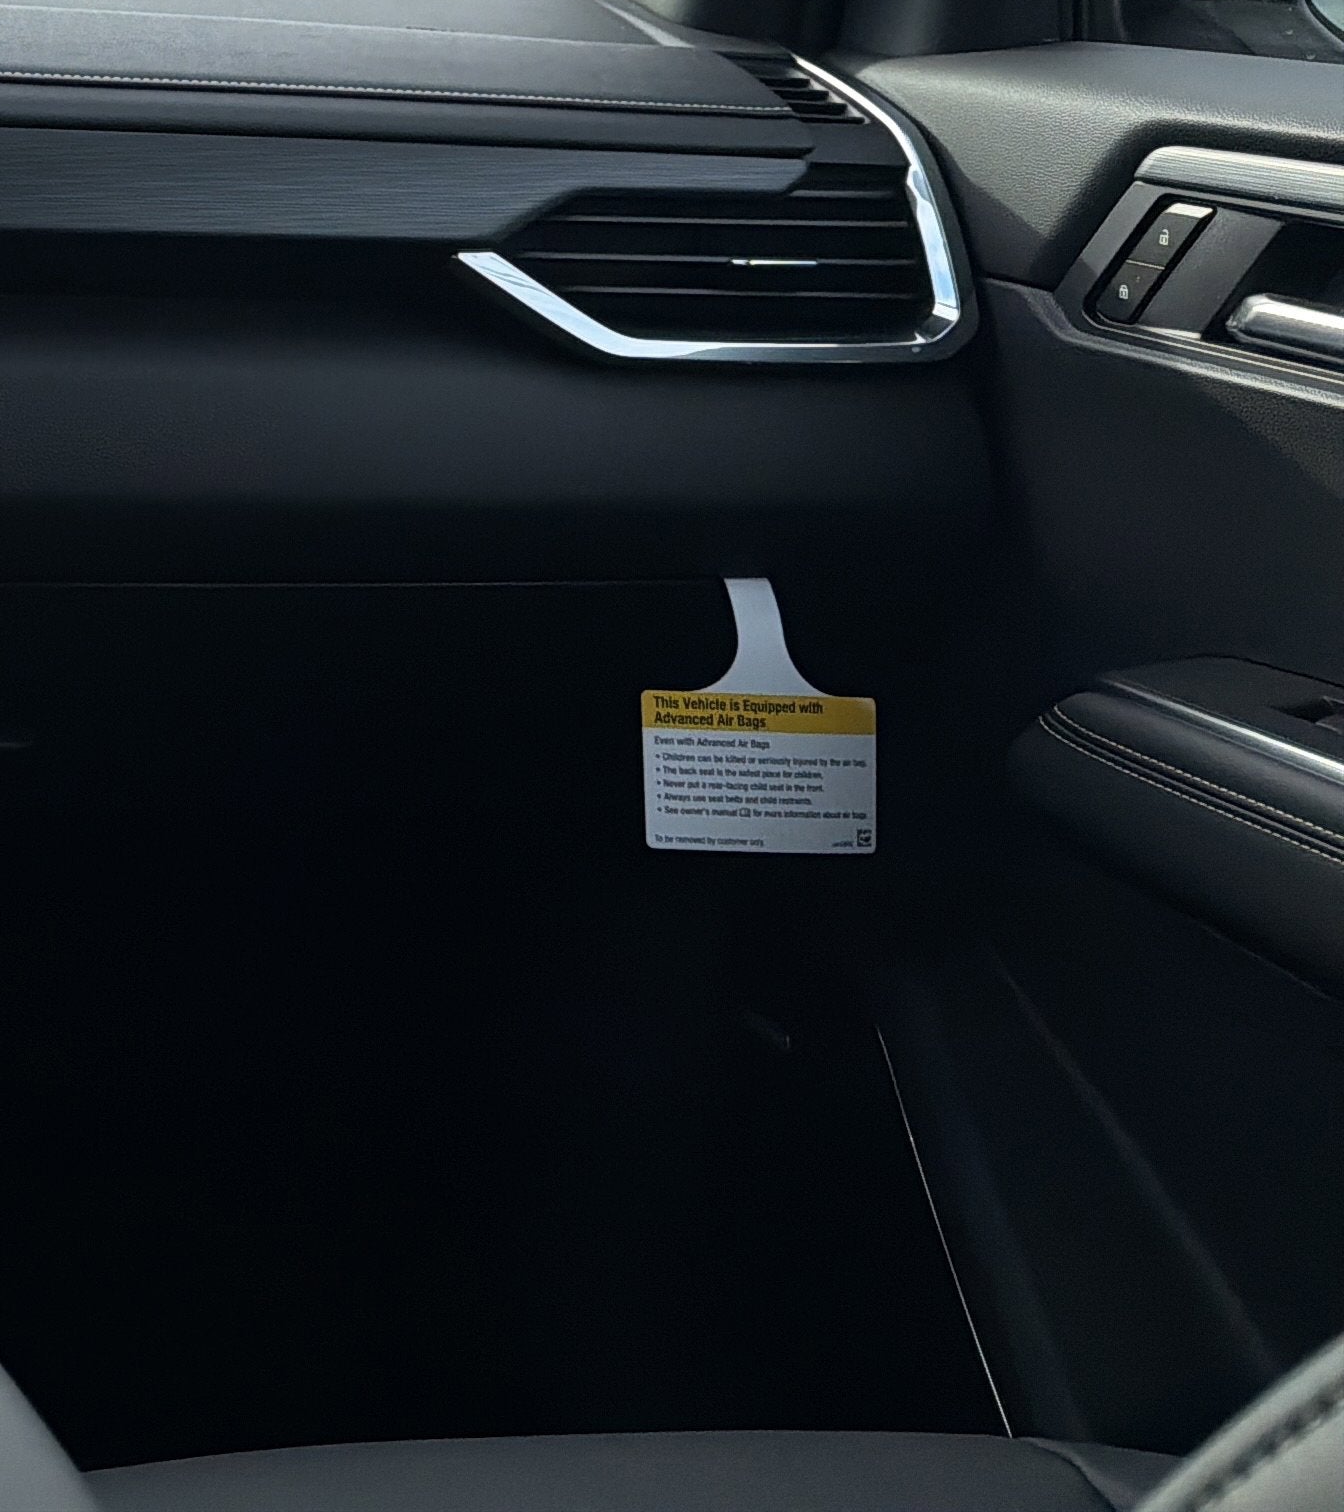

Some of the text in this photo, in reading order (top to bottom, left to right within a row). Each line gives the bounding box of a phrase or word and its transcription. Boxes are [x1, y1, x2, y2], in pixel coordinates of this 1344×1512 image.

[653, 695, 823, 715] This Vehicle is Equipped with
[654, 711, 767, 730] Advanced Air Bags
[654, 736, 770, 750] Even with Advanced Air Bags
